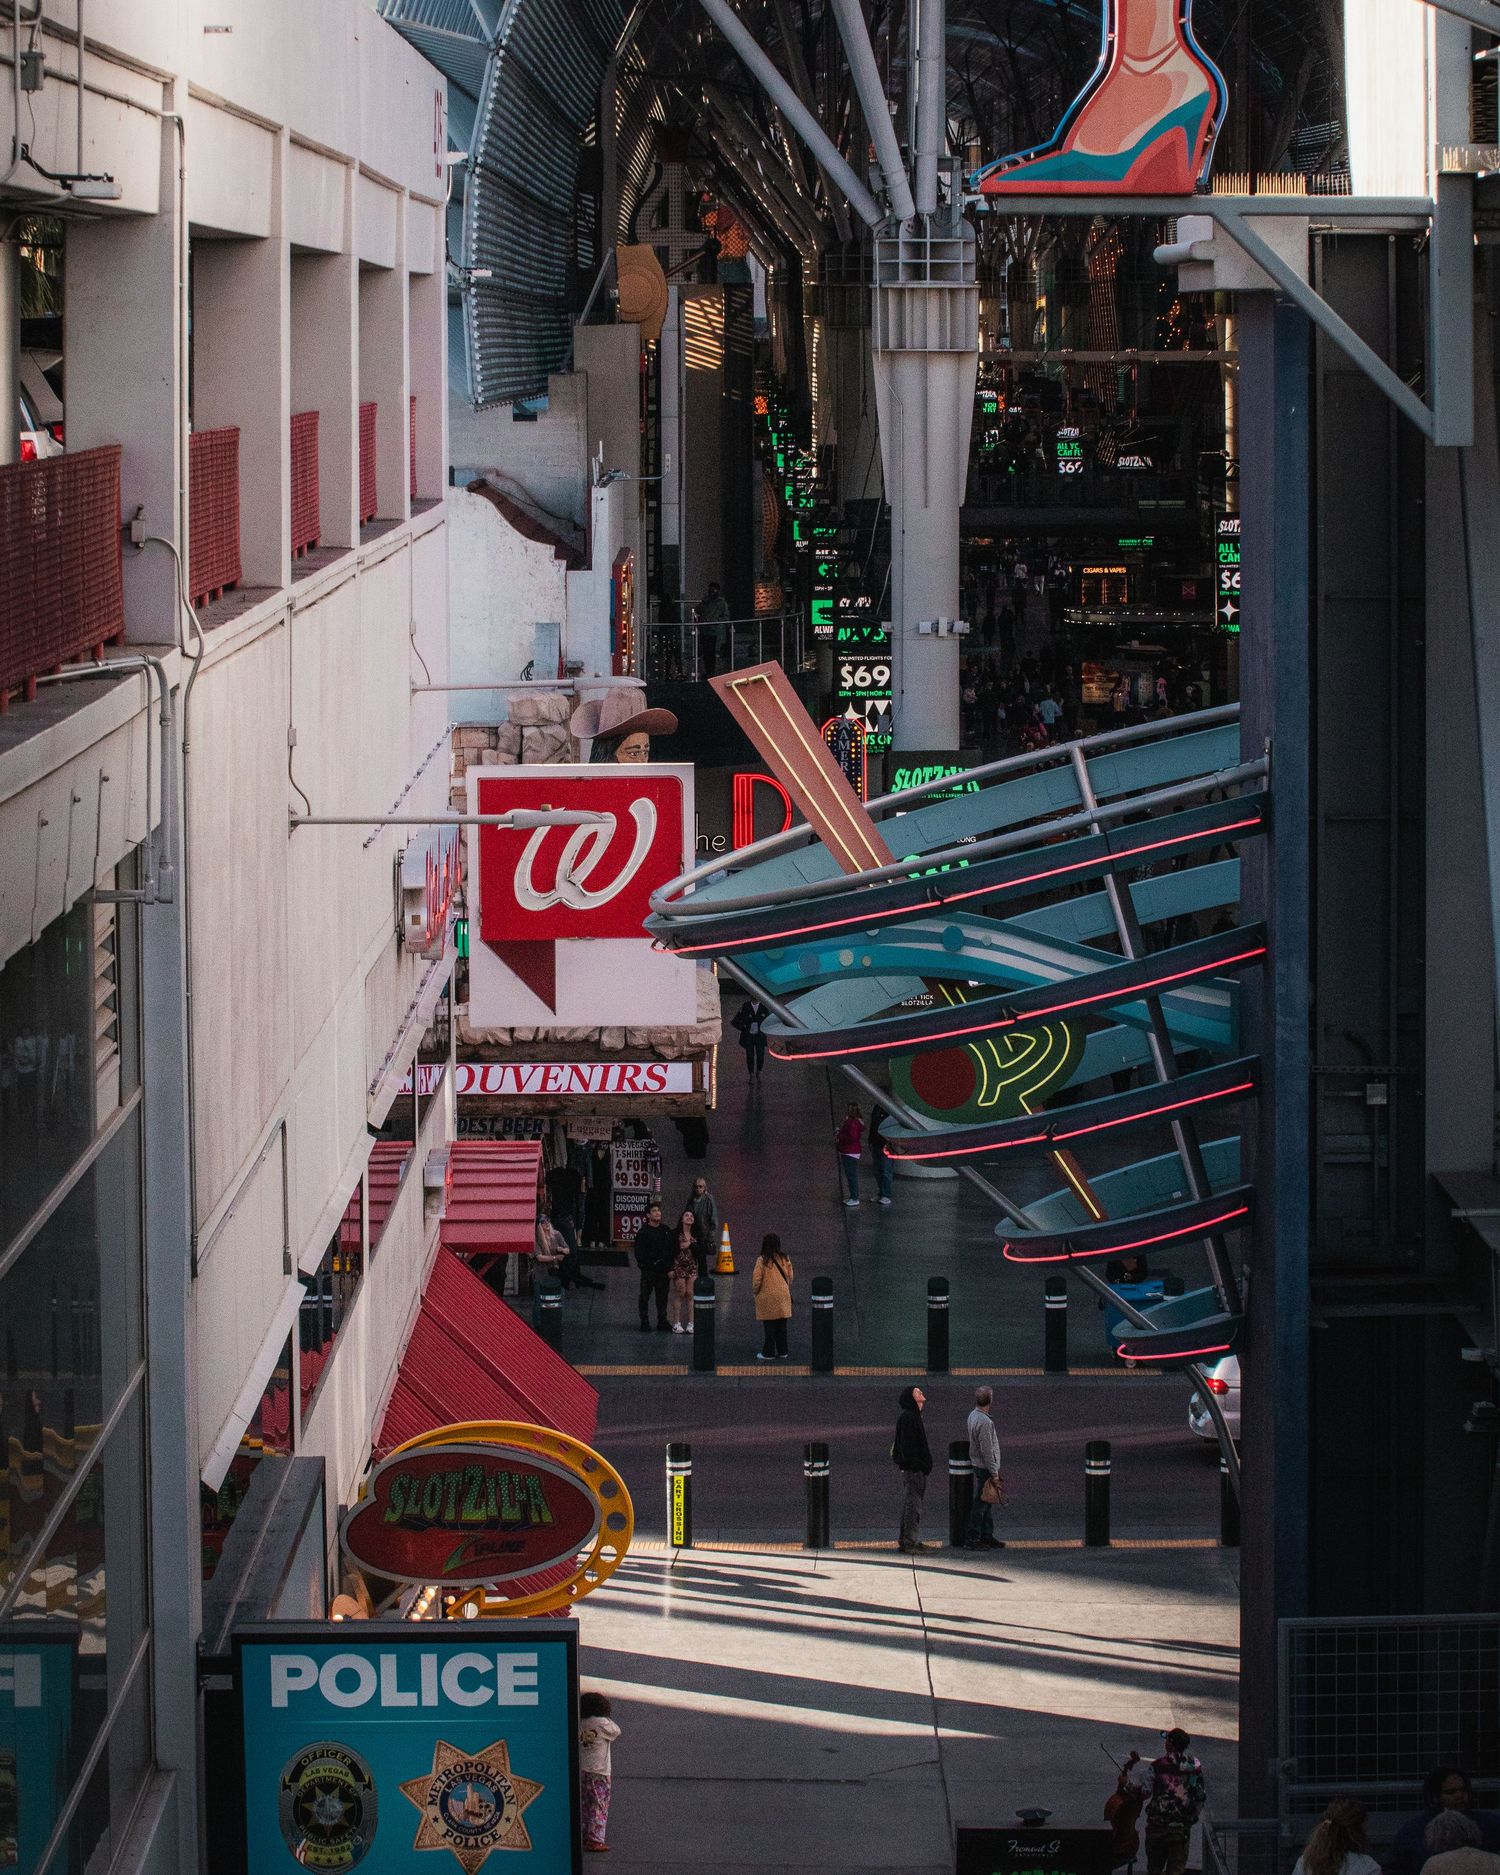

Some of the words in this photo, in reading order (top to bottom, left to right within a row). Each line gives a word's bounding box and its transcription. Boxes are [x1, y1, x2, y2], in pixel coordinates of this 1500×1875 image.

[1218, 543, 1235, 553] ALL
[840, 663, 891, 690] $69
[695, 812, 726, 853] he
[456, 1063, 669, 1094] OUVENIRS
[502, 1117, 544, 1135] BEER
[568, 1122, 611, 1136] Luggage
[615, 1160, 623, 1172] 4
[626, 1160, 648, 1172] FOR
[615, 1172, 649, 1187] $9.99
[614, 1203, 648, 1212] SOUVENIR
[615, 1195, 649, 1203] DISCOUNT
[383, 1463, 554, 1524] SLOTZILLA
[270, 1652, 539, 1708] POLICE
[301, 1749, 352, 1766] OFFICER
[305, 1768, 321, 1778] LAS
[323, 1766, 349, 1778] VEGAS
[427, 1761, 516, 1807] METROPOLITAN
[444, 1776, 463, 1793] LAS
[465, 1773, 499, 1793] VEGAS
[298, 1823, 328, 1845] PUBLIC
[441, 1828, 502, 1848] POLICE
